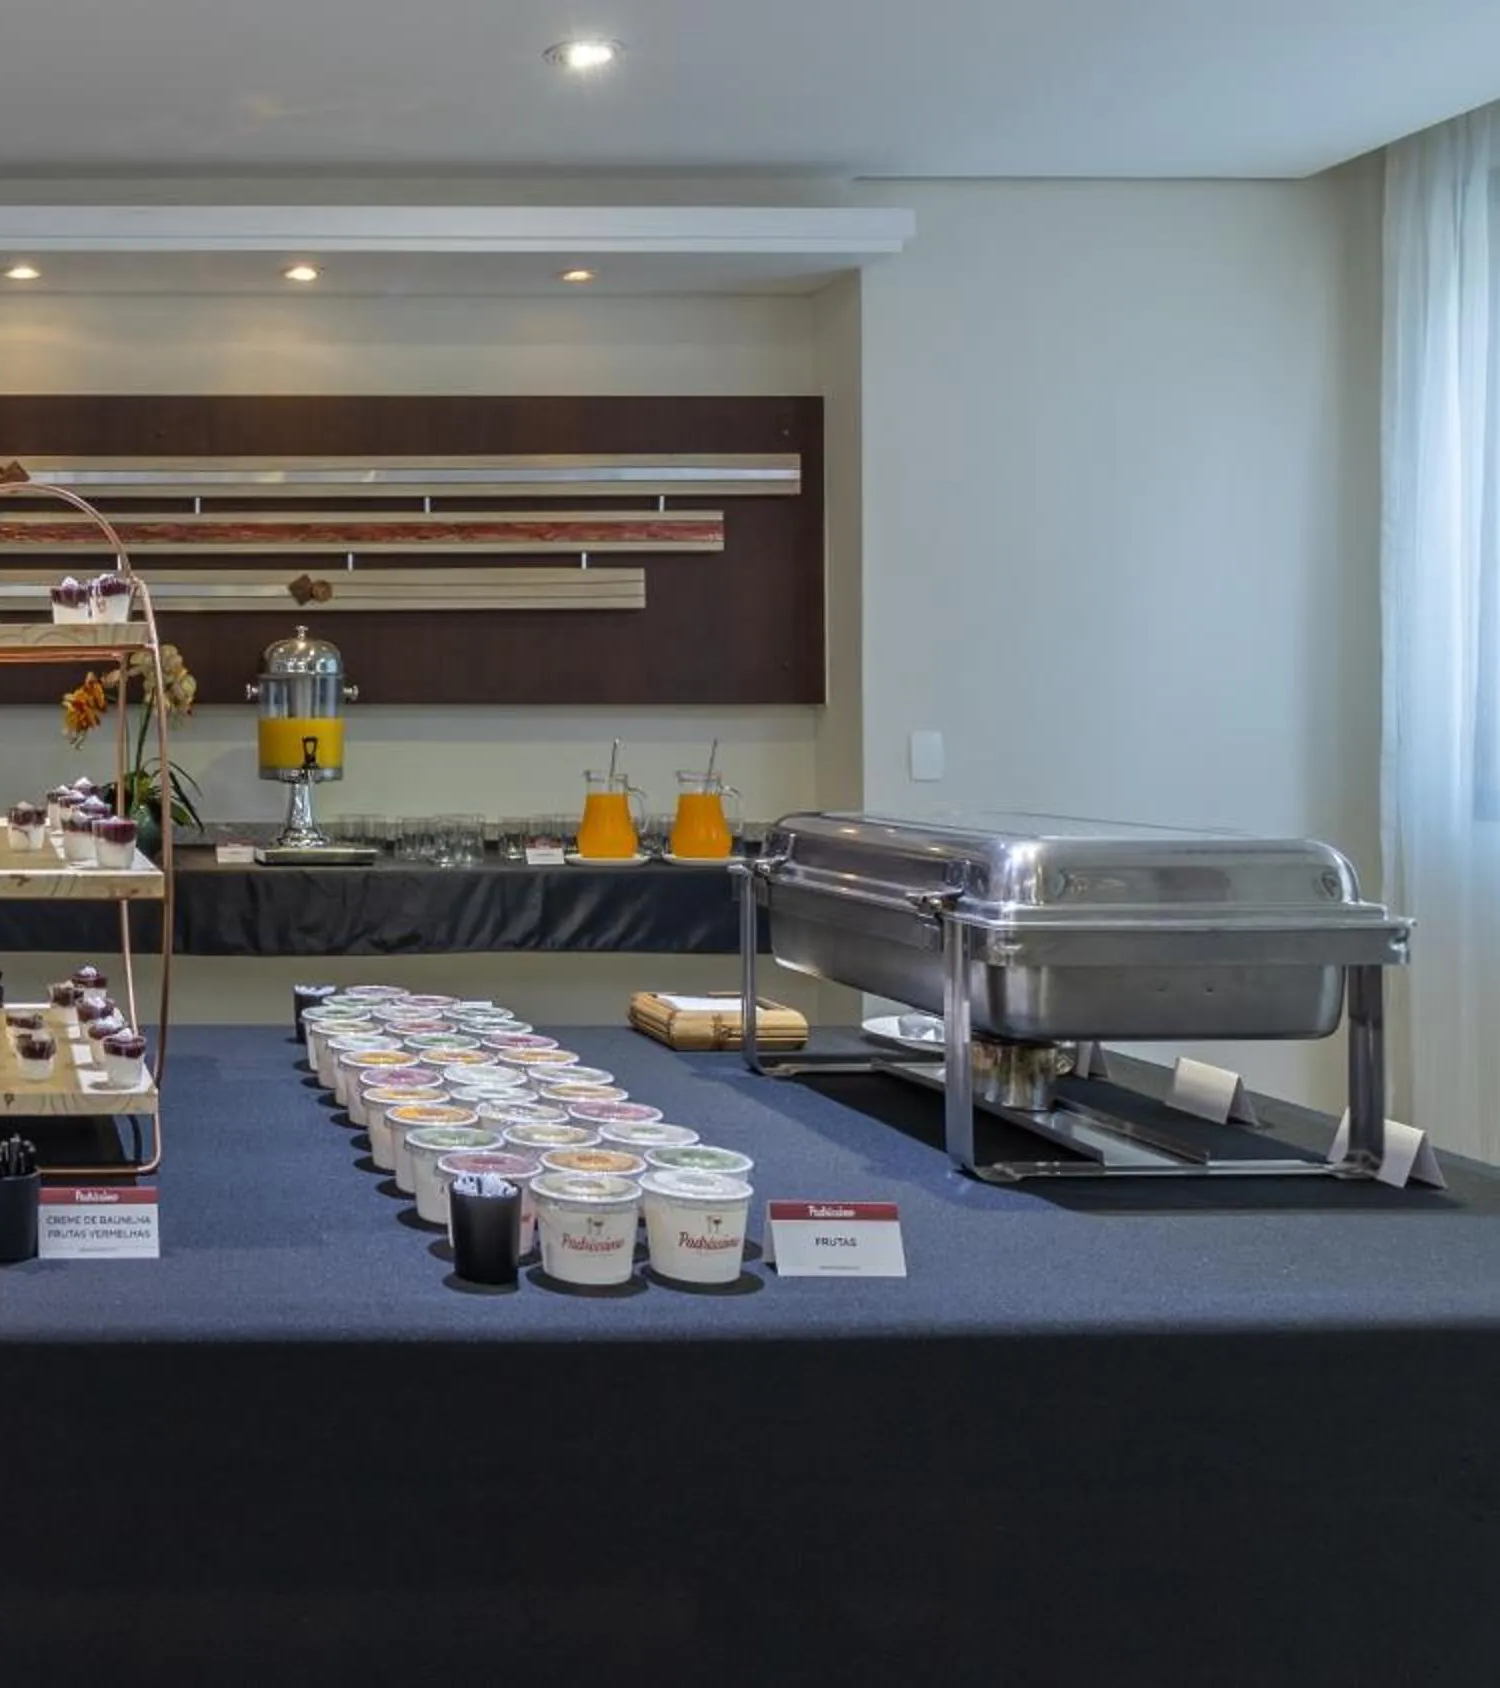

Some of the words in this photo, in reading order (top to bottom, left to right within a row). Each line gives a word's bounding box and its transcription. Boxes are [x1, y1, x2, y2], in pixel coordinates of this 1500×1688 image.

[45, 1215, 82, 1225] CREME
[83, 1215, 97, 1225] DE
[99, 1215, 152, 1225] BAUNILHA
[47, 1228, 87, 1239] FRUTAS
[89, 1228, 151, 1239] VERMELHAS
[815, 1237, 858, 1247] FRUTAS
